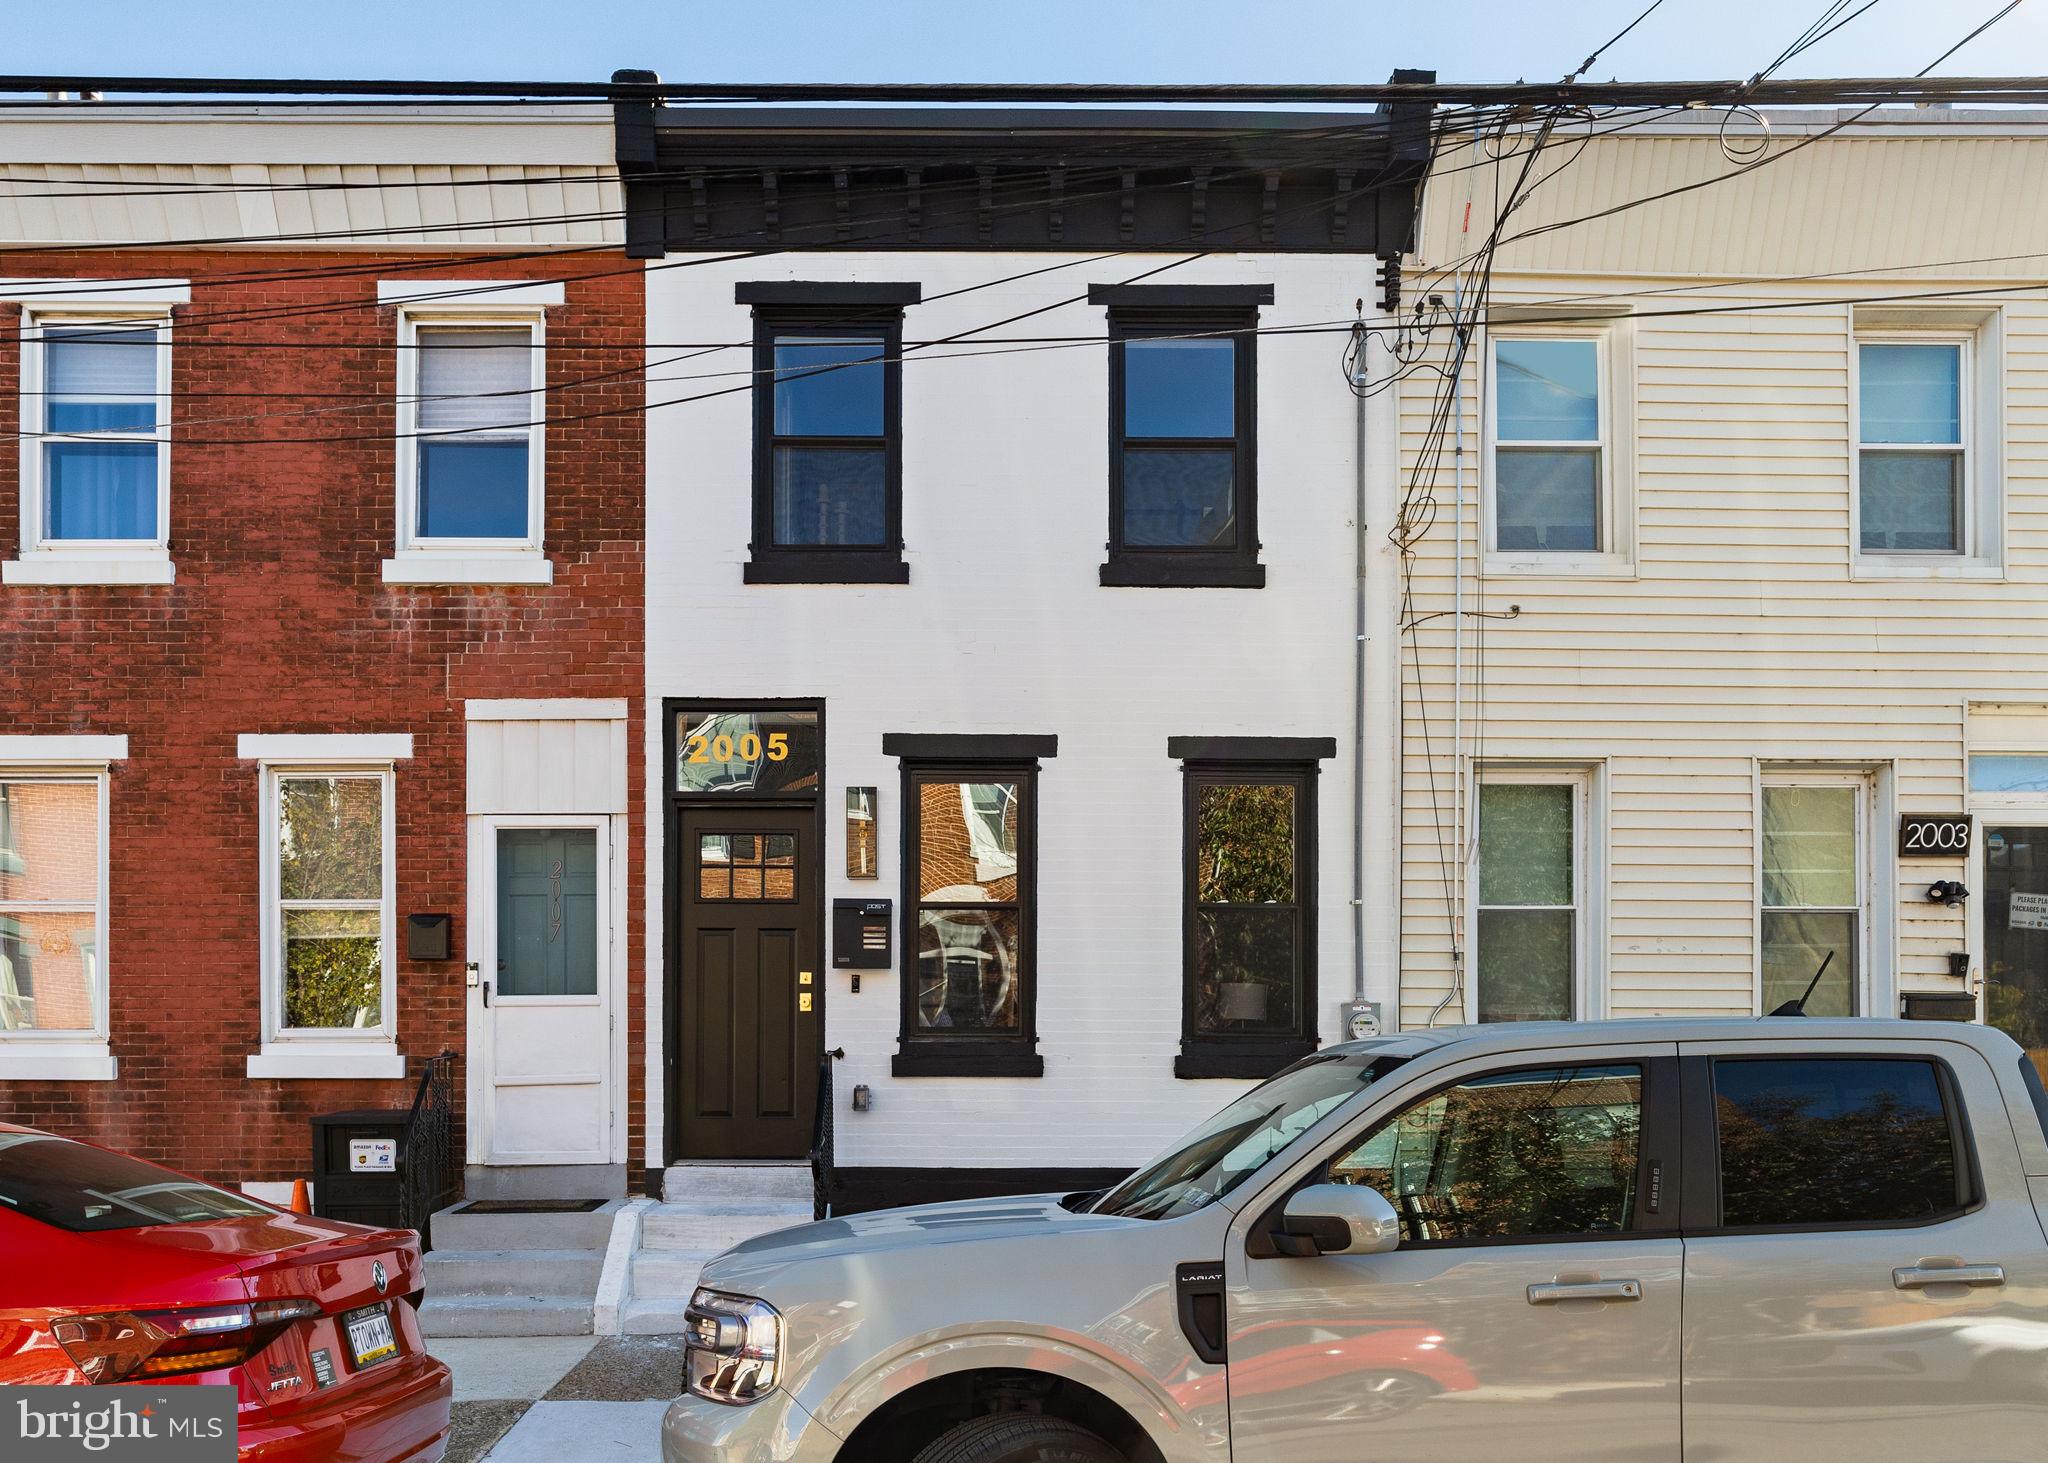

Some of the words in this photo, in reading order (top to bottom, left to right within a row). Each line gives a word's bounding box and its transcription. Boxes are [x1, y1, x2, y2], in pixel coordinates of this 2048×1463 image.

[687, 733, 789, 764] 2005
[1905, 822, 1969, 848] 2003
[549, 860, 563, 943] 2007
[2017, 896, 2037, 904] PLEASE
[2011, 905, 2039, 913] PACKAGES
[356, 1305, 376, 1318] SMITH
[267, 1376, 303, 1391] JETTA
